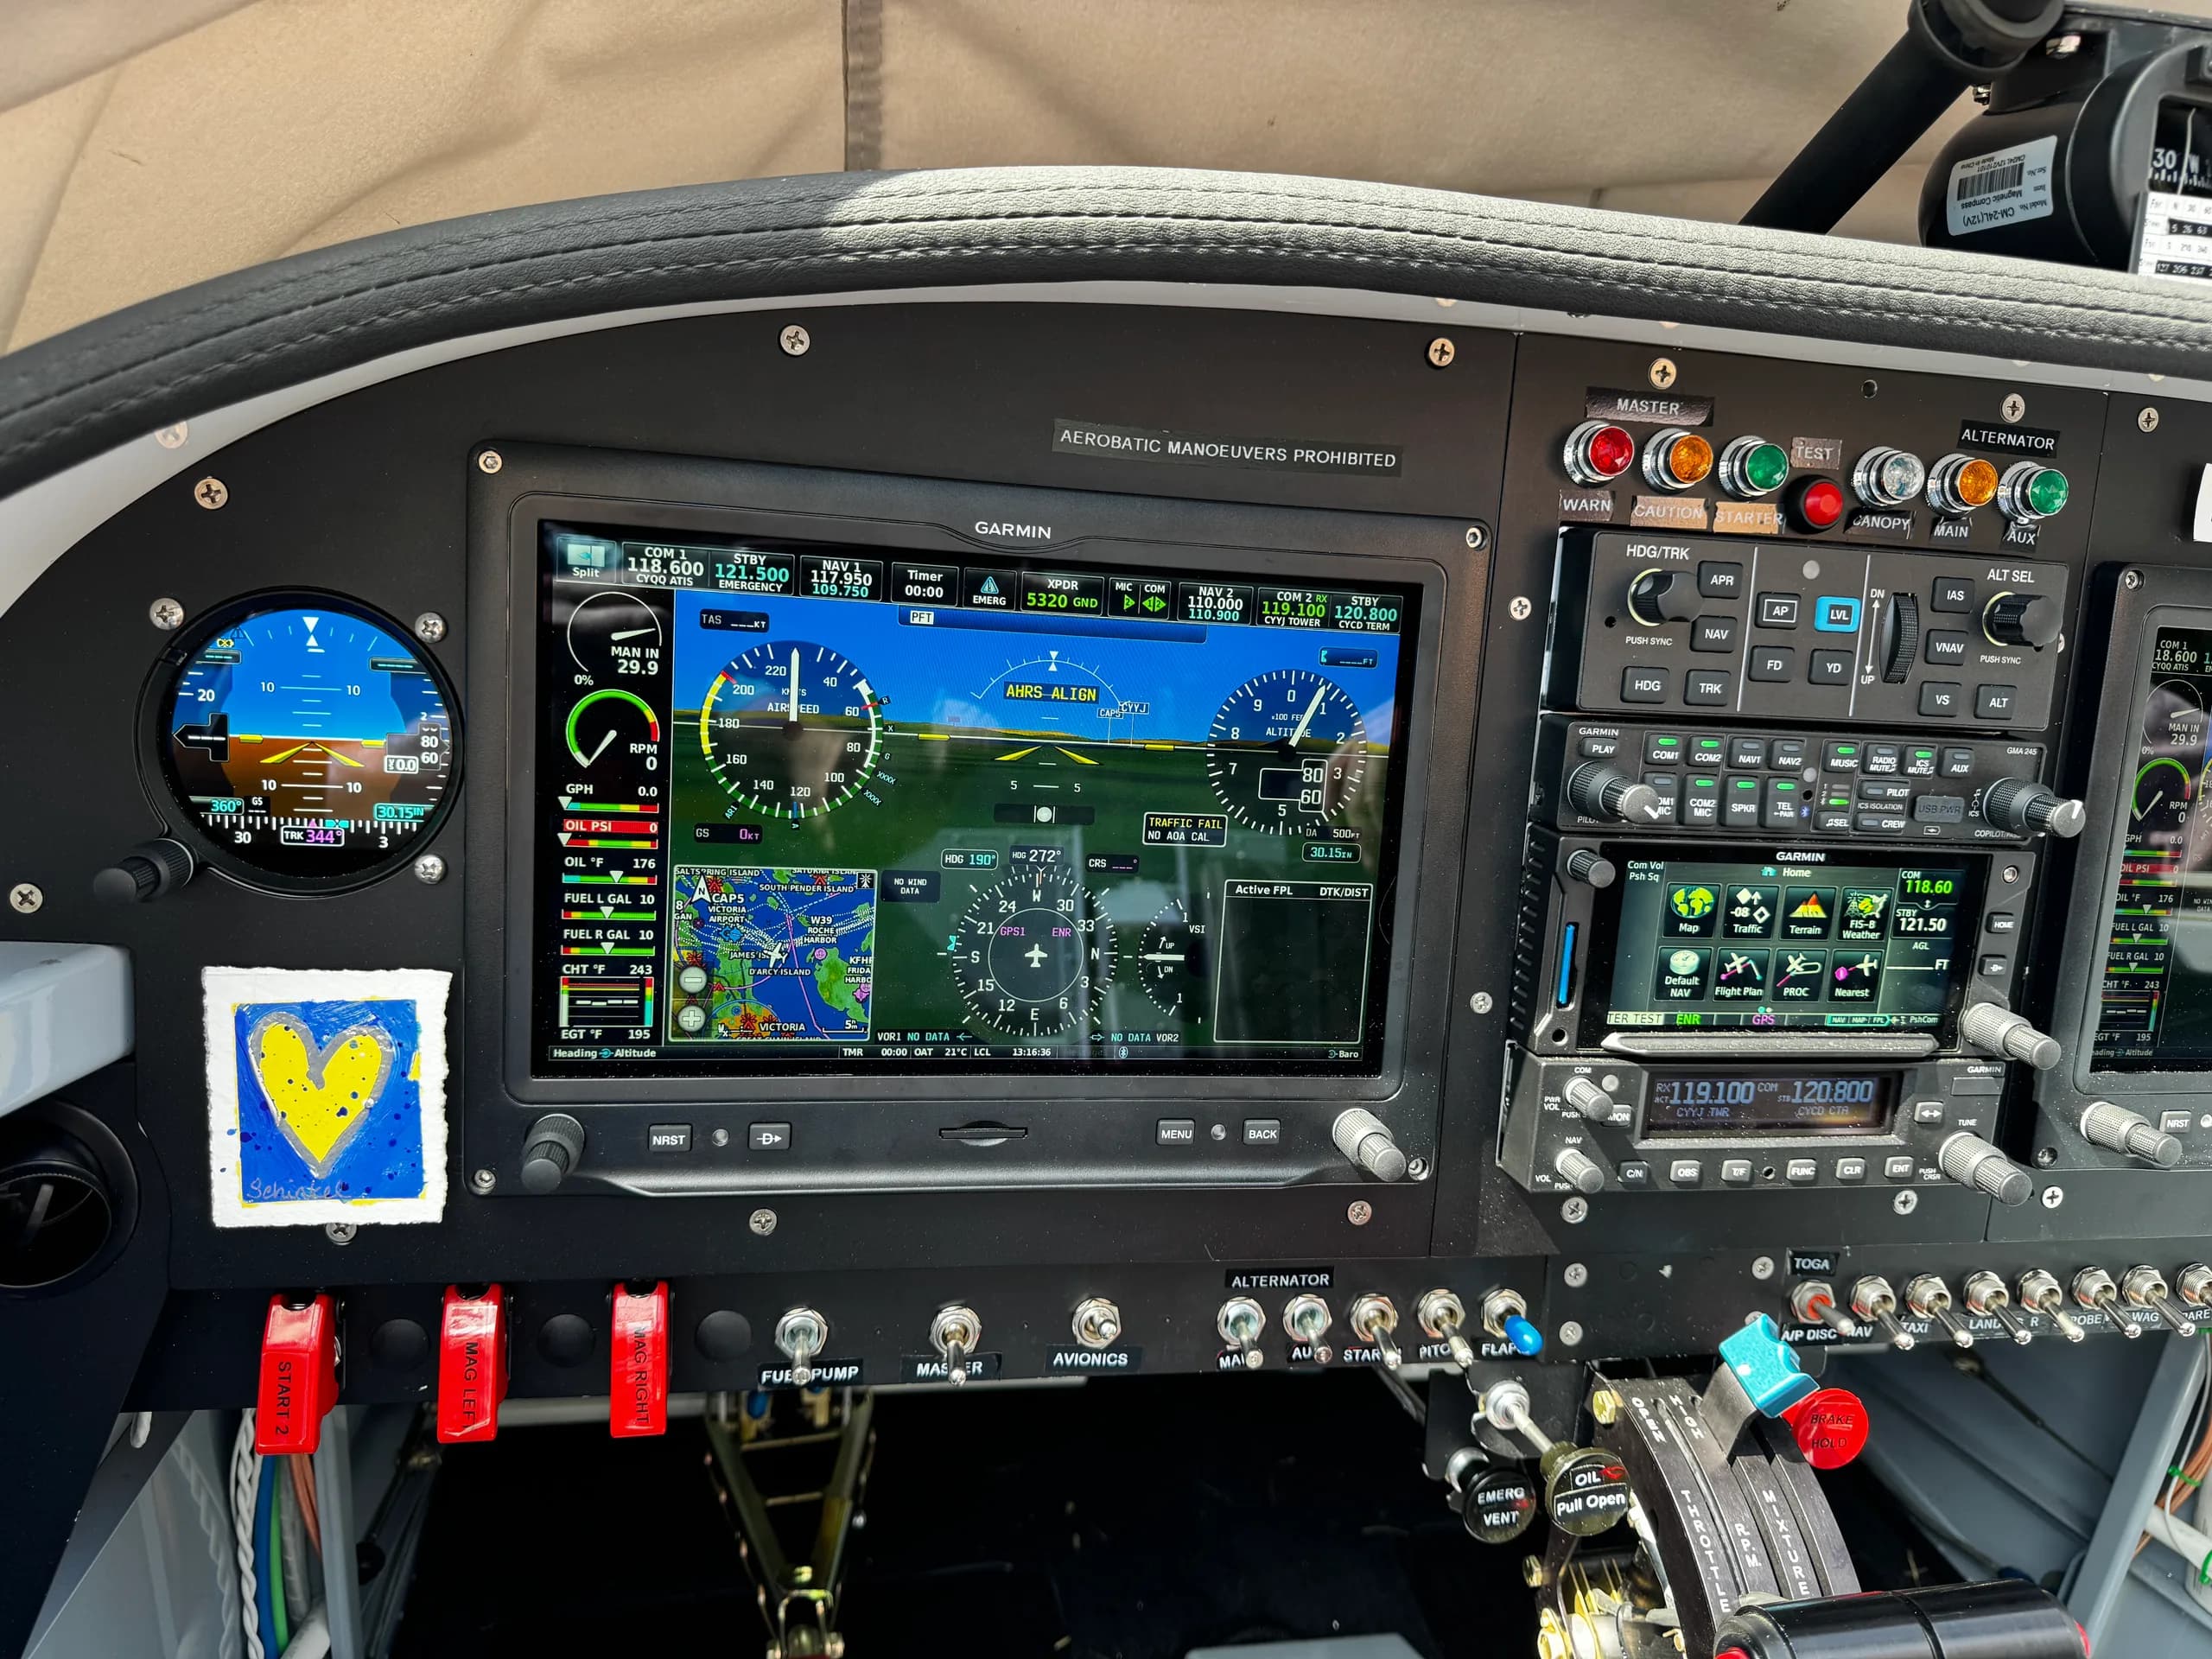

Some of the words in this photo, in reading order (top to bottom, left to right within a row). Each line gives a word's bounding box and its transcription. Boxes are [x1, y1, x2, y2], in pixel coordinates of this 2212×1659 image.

[1992, 189, 2022, 203] Magnetic
[1961, 197, 1991, 208] Compass
[1963, 207, 2014, 226] CM-24L(12V)
[1617, 399, 1680, 416] MASTER
[1961, 429, 2055, 451] ALTERNATOR
[1060, 429, 1161, 453] AEROBATIC
[1167, 442, 1287, 461] MANOEUVERS
[1293, 449, 1396, 467] PROHIBITED
[1796, 446, 1832, 461] TEST
[1563, 498, 1611, 513] WARN
[1634, 503, 1704, 520] CAUTION
[1715, 510, 1783, 527] STARTER
[1853, 515, 1910, 531] CANOPY
[975, 521, 1051, 540] GARMIN
[1934, 524, 1969, 539] MAIN
[2007, 530, 2036, 546] AUX
[645, 547, 675, 558] COM
[681, 550, 686, 560] 1
[1626, 544, 1690, 560] HDG/TRK
[734, 554, 766, 565] STBY
[628, 557, 704, 576] 118.600
[823, 560, 849, 571] NAV
[855, 563, 861, 572] 1
[573, 568, 600, 578] Split
[715, 564, 789, 582] 121.500
[811, 570, 872, 586] 117.950
[907, 570, 943, 582] Timer
[1987, 570, 2008, 582] ALT
[2012, 571, 2034, 582] SEL
[637, 575, 666, 585] CYQQ
[670, 576, 693, 586] ATIS
[719, 580, 783, 593] EMERGENCY
[1047, 579, 1078, 590] XPDR
[1711, 575, 1733, 586] APR
[812, 583, 868, 597] 109.750
[906, 586, 944, 598] 00:00
[1199, 587, 1223, 597] NAV
[1227, 588, 1233, 597] 2
[1947, 590, 1964, 601] IAS
[973, 595, 1007, 606] EMERG
[1027, 593, 1067, 607] 5320
[1073, 597, 1097, 608] GND
[1188, 596, 1243, 610] 110.000
[1277, 592, 1303, 602] COM
[1306, 594, 1312, 602] 2
[1351, 596, 1379, 606] STBY
[1189, 608, 1239, 621] 110.900
[1262, 601, 1325, 618] 119.100
[1334, 607, 1397, 621] 120.800
[1772, 605, 1789, 617] AP
[1830, 609, 1849, 620] LVL
[912, 613, 932, 624] PFT
[1264, 616, 1286, 627] CYYJ
[1288, 618, 1320, 627] TOWER
[1338, 620, 1363, 629] CYCD
[1366, 622, 1389, 631] TERM
[1704, 629, 1728, 640] NAV
[1626, 636, 1647, 646] PUSH
[1650, 638, 1673, 647] SYNC
[611, 647, 639, 658] MAN
[645, 647, 659, 658] IN
[1936, 642, 1964, 654] VNAV
[618, 660, 658, 675] 29.9
[1635, 679, 1661, 692] HDG
[1699, 683, 1722, 695] TRK
[1007, 685, 1042, 700] AHRS
[1052, 687, 1096, 702] ALIGN
[1989, 697, 2008, 709] ALT
[1579, 728, 1618, 736] GARMIN
[630, 744, 658, 755] RPM
[1592, 745, 1615, 754] PLAY
[1653, 751, 1678, 760] COM1
[1695, 753, 1721, 762] COM2
[1738, 755, 1761, 764] NAV1
[1779, 757, 1802, 766] NAV2
[1830, 759, 1858, 767] MUSIC
[1732, 804, 1755, 813] SPKR
[565, 821, 587, 831] OIL
[591, 821, 612, 832] PSI
[1149, 817, 1192, 829] TRAFFIC
[1198, 819, 1223, 830] FAIL
[284, 831, 303, 840] TRK
[565, 857, 586, 868] OIL
[1776, 852, 1825, 862] GARMIN
[633, 859, 656, 868] 176
[1783, 867, 1811, 878] Home
[1236, 884, 1269, 896] Active
[1274, 885, 1293, 896] FPL
[1319, 887, 1369, 899] DTK/DIST
[1905, 879, 1952, 895] 118.60
[564, 893, 593, 904] FUEL
[596, 894, 604, 904] L
[608, 894, 632, 905] GAL
[1679, 923, 1699, 934] Map
[1733, 923, 1763, 934] Traffic
[1789, 925, 1821, 936] Terrain
[1898, 917, 1946, 932] 121.50
[1842, 930, 1880, 940] Weather
[563, 964, 588, 974] CHT
[630, 965, 652, 975] 243
[1664, 976, 1700, 986] Default
[1669, 988, 1691, 997] NAV
[1715, 986, 1740, 998] Flight
[1743, 987, 1764, 997] Plan
[1783, 987, 1809, 997] PROC
[1835, 987, 1869, 998] Nearest
[553, 1048, 597, 1059] Heading
[614, 1048, 656, 1058] Altitude
[1013, 1047, 1051, 1058] 13:16:36
[1338, 1049, 1358, 1059] Baro
[1670, 1082, 1755, 1104] 119.100
[1791, 1081, 1874, 1104] 120.800
[652, 1134, 685, 1145] NRST
[1160, 1128, 1193, 1140] MENU
[1248, 1128, 1277, 1141] BACK
[1627, 1169, 1643, 1178] C/N
[1892, 1165, 1910, 1173] ENT
[1795, 1257, 1829, 1270] TOGA
[1231, 1274, 1329, 1287] ALTERNATOR
[1781, 1329, 1806, 1342] A/P
[1808, 1327, 1837, 1340] DISC
[632, 1326, 645, 1368] MAG
[464, 1341, 478, 1383] MAG
[1053, 1352, 1128, 1365] AVIONICS
[761, 1370, 792, 1383] FUE
[811, 1366, 859, 1382] PUMP
[276, 1361, 291, 1420] START
[632, 1372, 649, 1425] RIGHT
[1810, 1414, 1853, 1426] BRAKE
[275, 1425, 289, 1436] 2
[1812, 1437, 1847, 1449] HOLD
[1575, 1471, 1601, 1486] OIL
[1478, 1487, 1524, 1503] EMERG
[1557, 1496, 1586, 1516] Pull
[1592, 1491, 1625, 1510] Open
[1484, 1510, 1517, 1525] VENT
[1764, 1490, 1808, 1595] MIXTURE
[1681, 1490, 1731, 1612] THROTTLE
